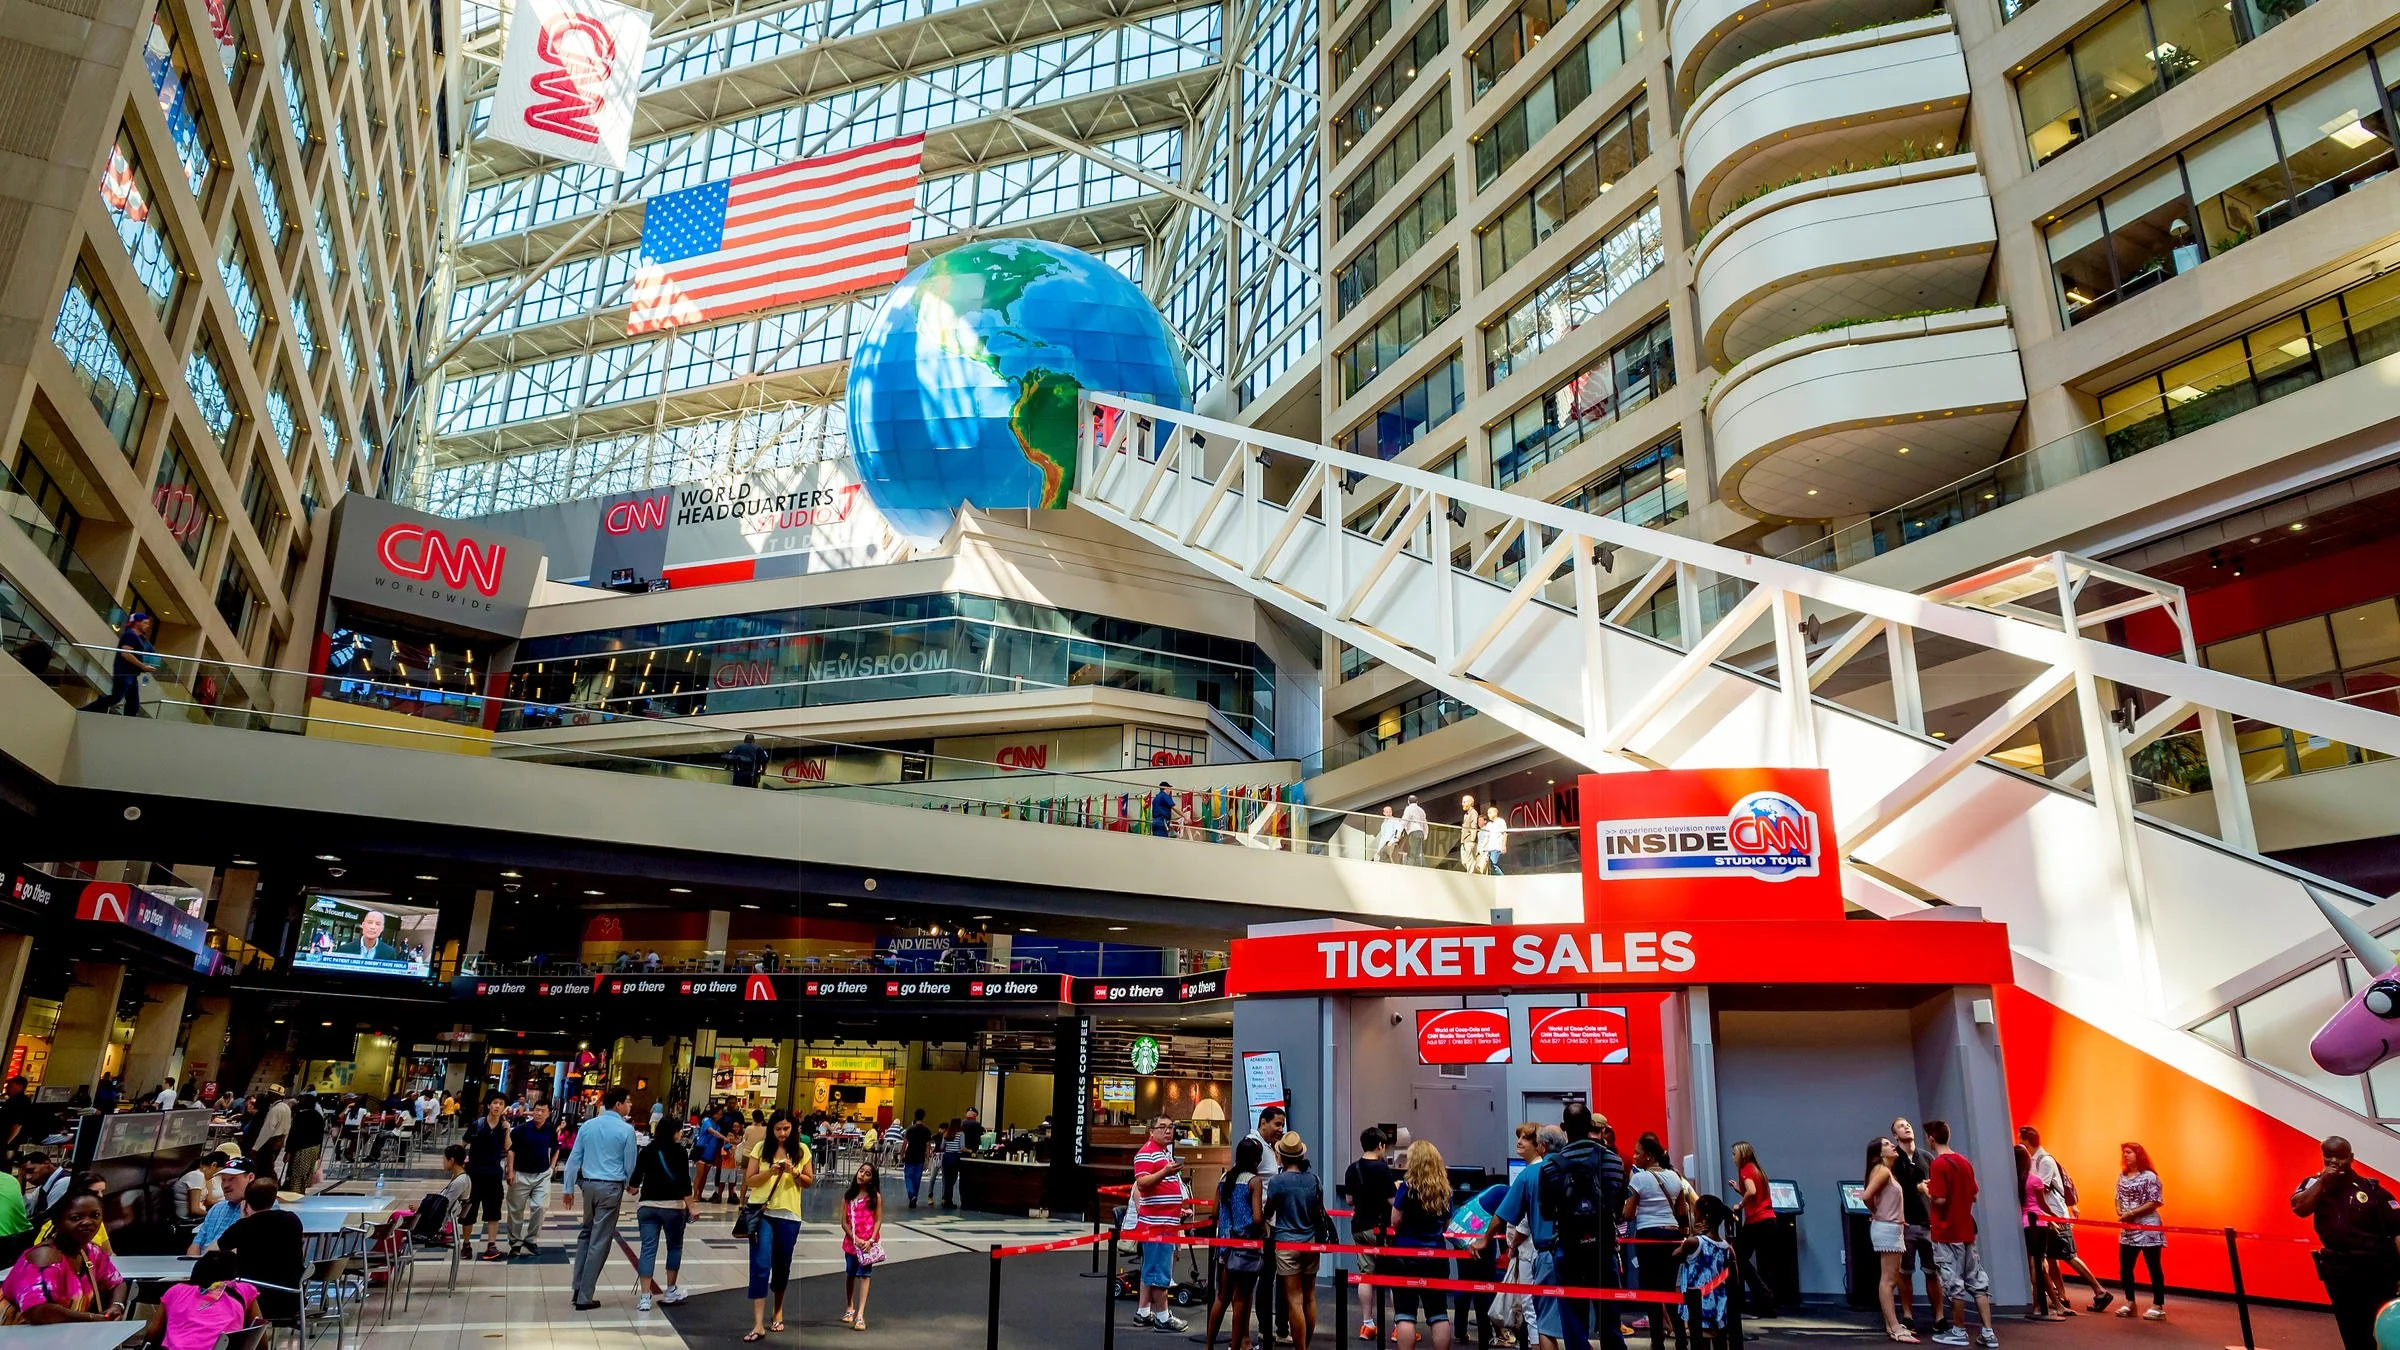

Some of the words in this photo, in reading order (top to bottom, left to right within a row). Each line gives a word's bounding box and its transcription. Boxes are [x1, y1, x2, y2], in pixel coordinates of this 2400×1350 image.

[523, 12, 616, 144] CNN
[677, 488, 834, 526] HEADQUARTERS
[681, 483, 750, 507] WORLD
[605, 495, 669, 536] CNN
[757, 508, 832, 532] STUDIO
[838, 483, 862, 521] 7
[376, 522, 506, 597] CNN
[375, 577, 492, 611] WORLDWIDE
[714, 657, 772, 689] CNN
[808, 648, 948, 682] NEWSROOM
[996, 745, 1048, 771] CNN
[782, 759, 827, 783] CNN
[1509, 794, 1556, 836] CNN
[1606, 832, 1728, 855] INSIDE
[1728, 816, 1811, 854] CNN
[1619, 826, 1662, 835] experience
[1664, 825, 1703, 833] television
[1715, 856, 1766, 866] STUDIO
[1769, 856, 1807, 866] TOUR
[21, 883, 33, 900] go
[32, 883, 51, 905] there
[889, 938, 912, 950] AND
[916, 937, 950, 950] VIEWS
[1318, 936, 1496, 979] TICKET
[1511, 931, 1696, 975] SALES
[488, 984, 500, 995] go
[501, 983, 526, 993] there
[550, 985, 563, 996] go
[565, 984, 590, 994] there
[623, 983, 637, 994] go
[638, 982, 665, 992] there
[693, 982, 707, 993] go
[708, 982, 737, 992] there
[820, 983, 835, 995] go
[837, 982, 868, 993] there
[901, 983, 916, 995] go
[919, 982, 950, 994] there
[986, 983, 1001, 995] go
[1004, 982, 1038, 994] there
[1109, 988, 1126, 999] go
[1130, 984, 1164, 998] there
[1188, 984, 1198, 997] go
[1198, 981, 1216, 994] there
[1079, 1019, 1089, 1074] COFFEE
[864, 1059, 878, 1069] grill
[1074, 1077, 1086, 1166] STARBUCKS
